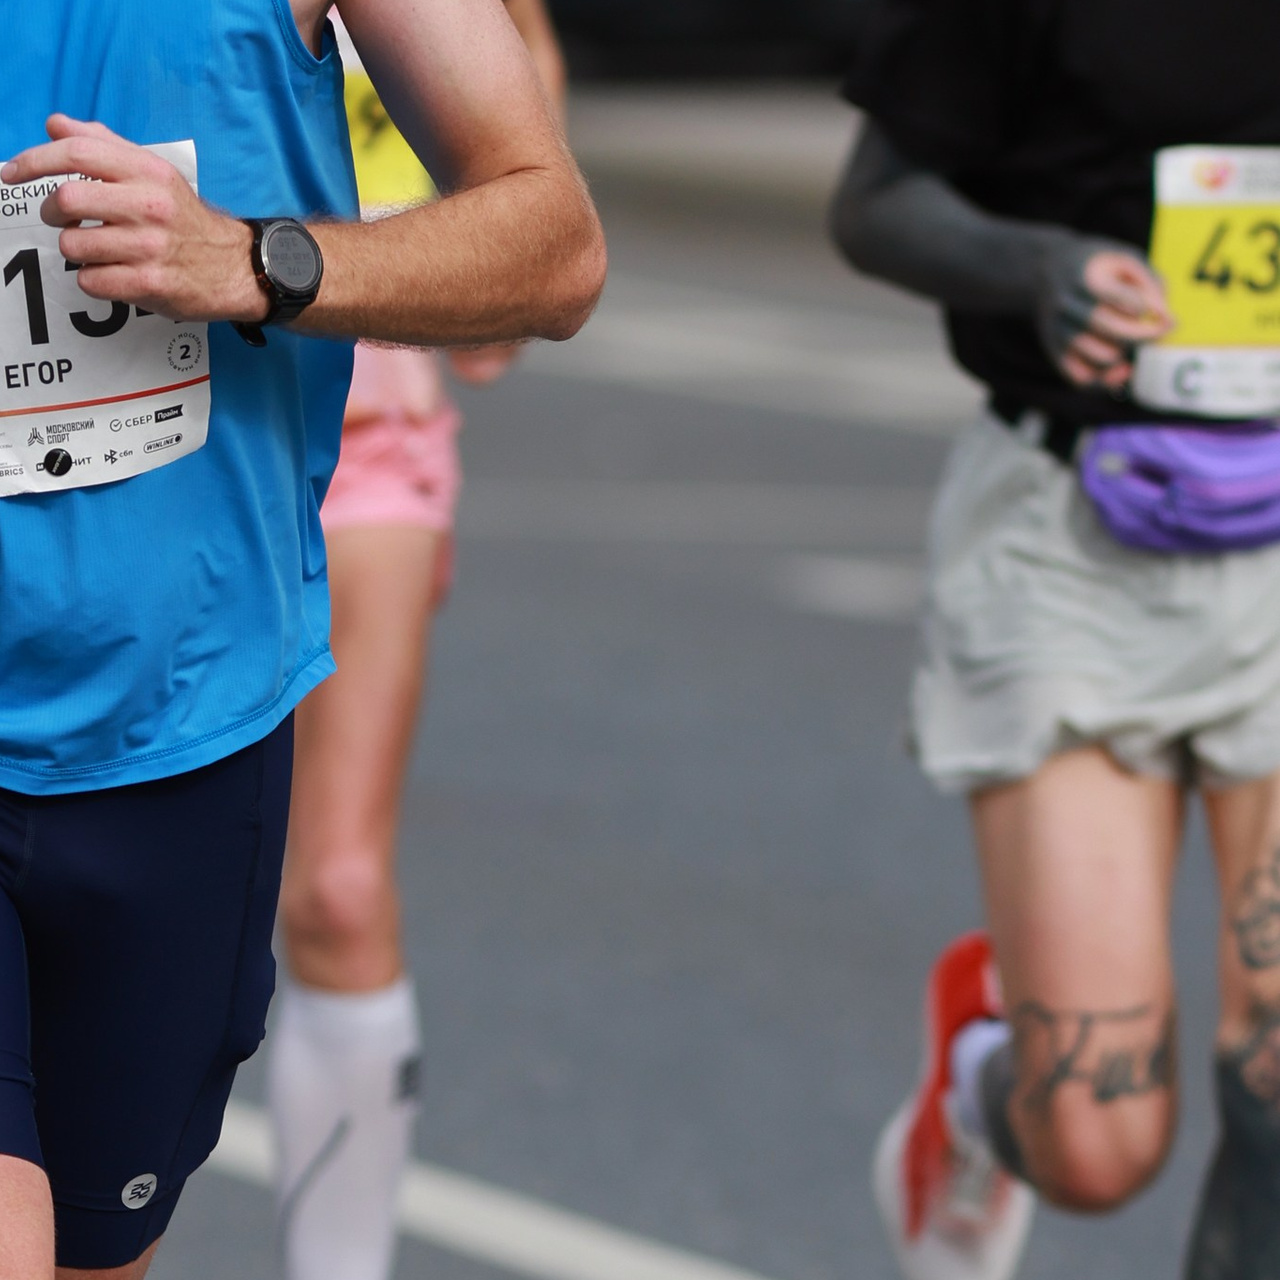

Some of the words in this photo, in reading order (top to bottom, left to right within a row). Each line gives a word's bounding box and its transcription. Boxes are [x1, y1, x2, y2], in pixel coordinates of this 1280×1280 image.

[180, 344, 191, 360] 2
[4, 358, 73, 389] ЕГОР
[46, 418, 95, 434] МОСКОВСКИЙ
[125, 415, 153, 428] СБЕР
[47, 433, 70, 445] СПОРТ
[146, 437, 175, 451] WINLINE
[119, 450, 133, 458] сбп
[0, 467, 24, 477] BRICS
